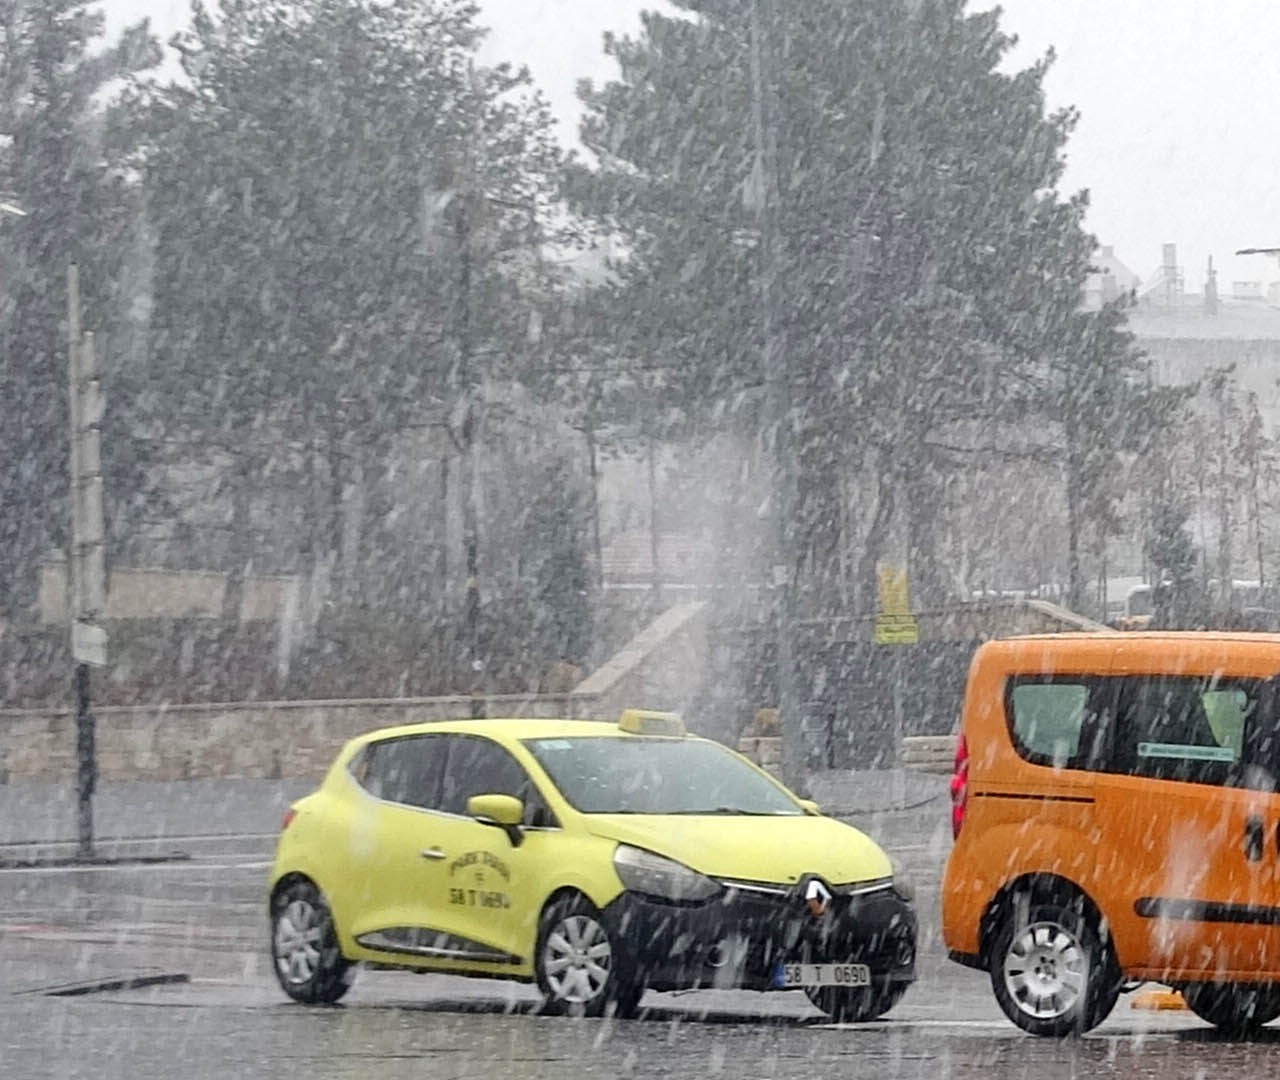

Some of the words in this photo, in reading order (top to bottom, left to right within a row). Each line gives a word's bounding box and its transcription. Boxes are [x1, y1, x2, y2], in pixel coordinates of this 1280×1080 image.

[785, 966, 802, 983] 58
[815, 966, 822, 982] T
[834, 966, 866, 983] 0690
